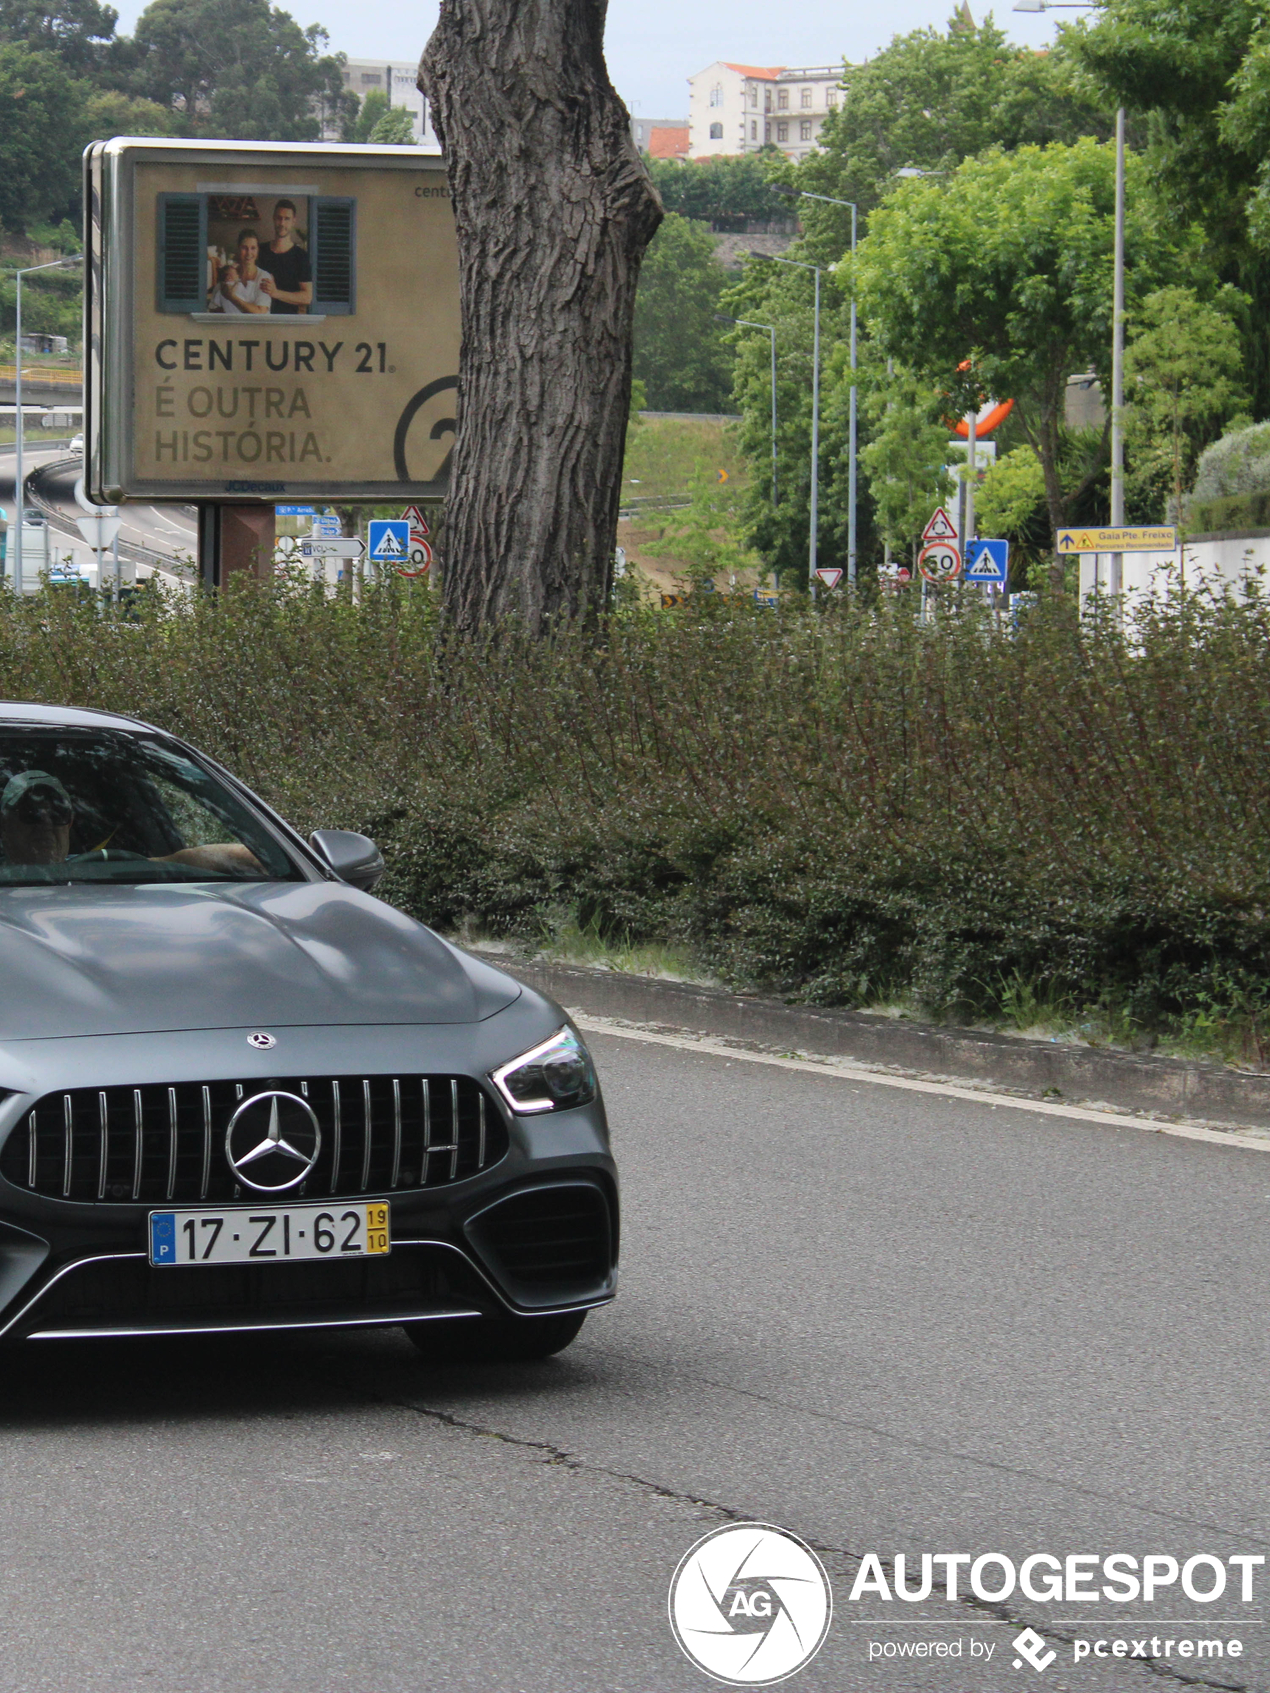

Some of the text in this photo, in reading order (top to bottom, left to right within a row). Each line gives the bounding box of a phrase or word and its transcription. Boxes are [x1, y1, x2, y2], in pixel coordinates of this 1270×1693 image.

[155, 338, 344, 372] CENTURY
[155, 376, 312, 419] É OUTRA
[155, 421, 332, 463] HISTÓRIA.
[225, 480, 286, 492] JCDecaux
[1098, 530, 1172, 540] Gaia Pte. Freixo
[368, 1210, 386, 1225] 19
[368, 1233, 387, 1250] 10
[159, 1245, 169, 1256] P
